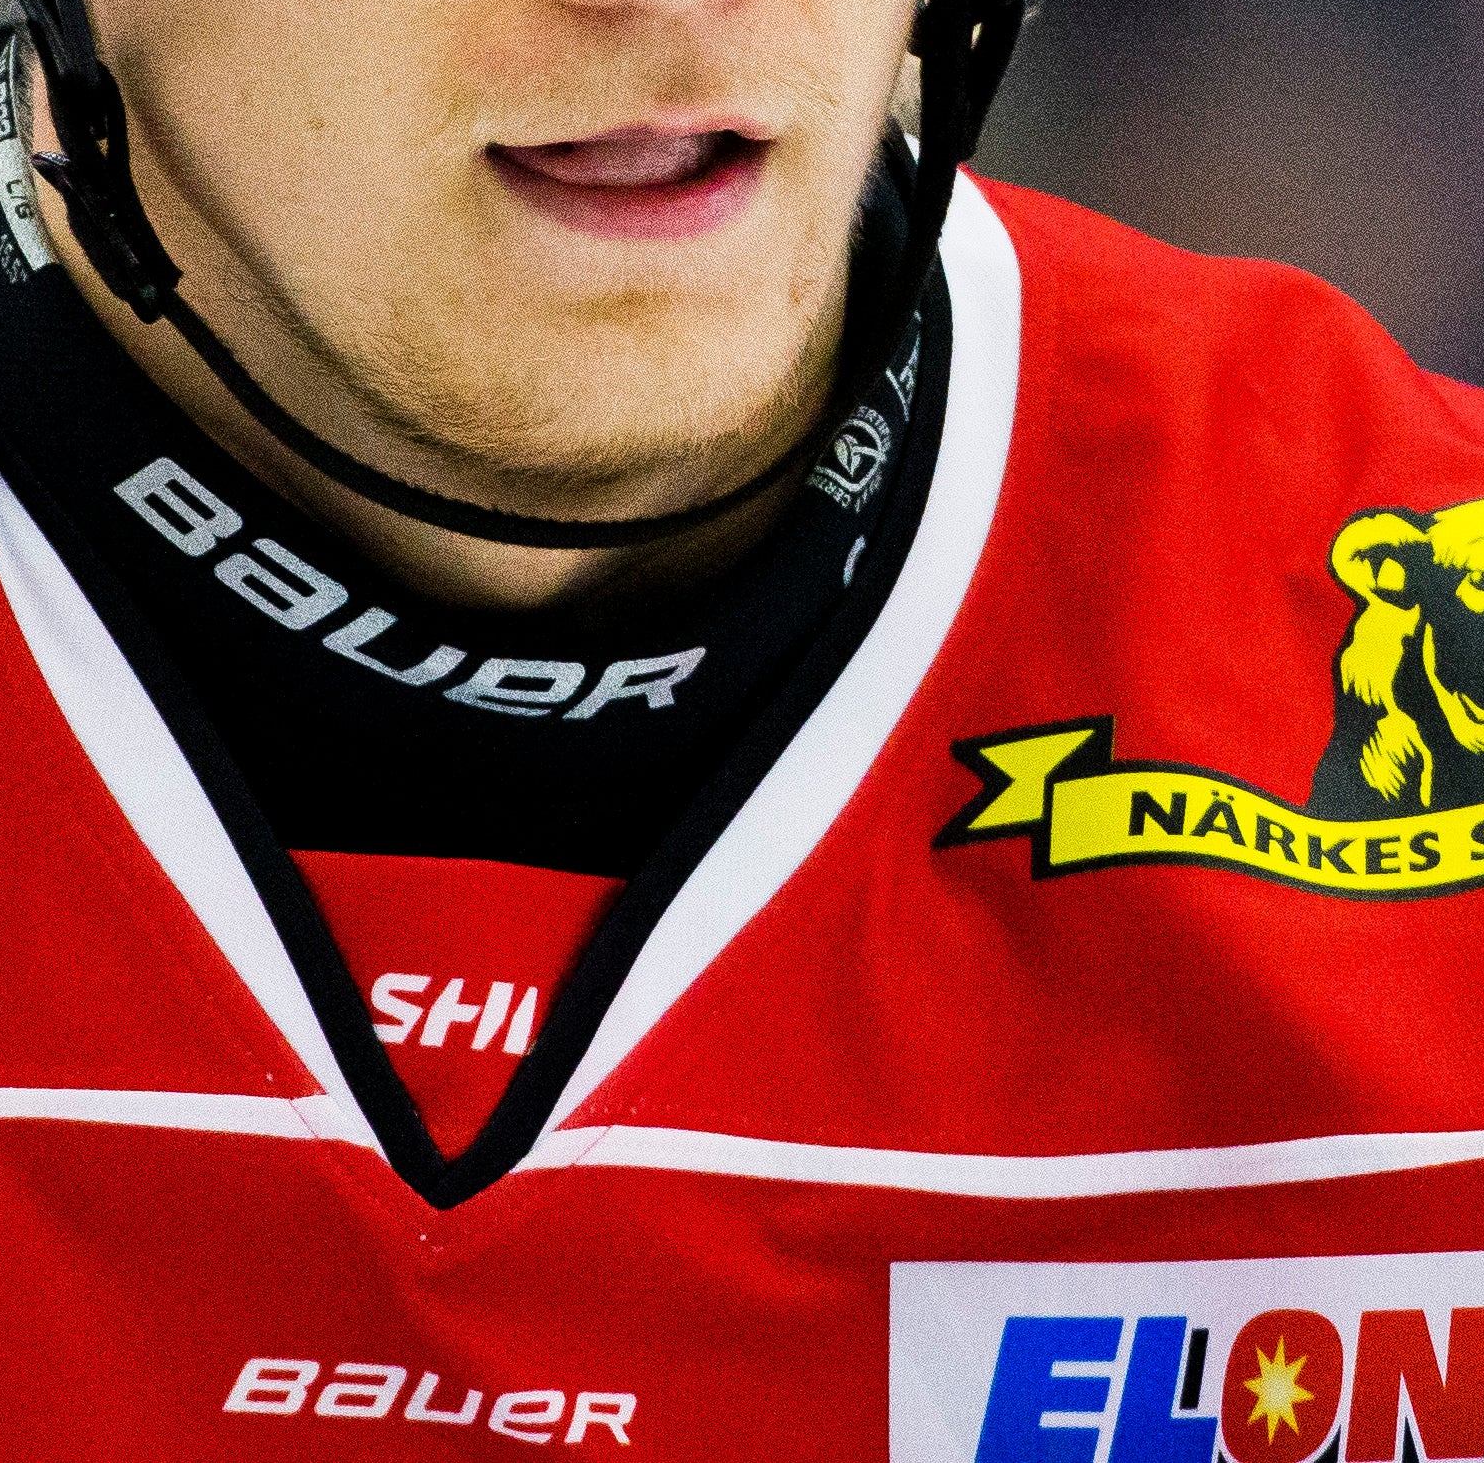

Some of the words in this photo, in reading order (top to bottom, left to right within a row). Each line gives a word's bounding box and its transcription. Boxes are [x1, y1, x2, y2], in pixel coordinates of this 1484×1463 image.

[114, 456, 707, 719] BAUER
[1127, 789, 1441, 875] NÄRKES
[222, 1357, 638, 1445] BAUER
